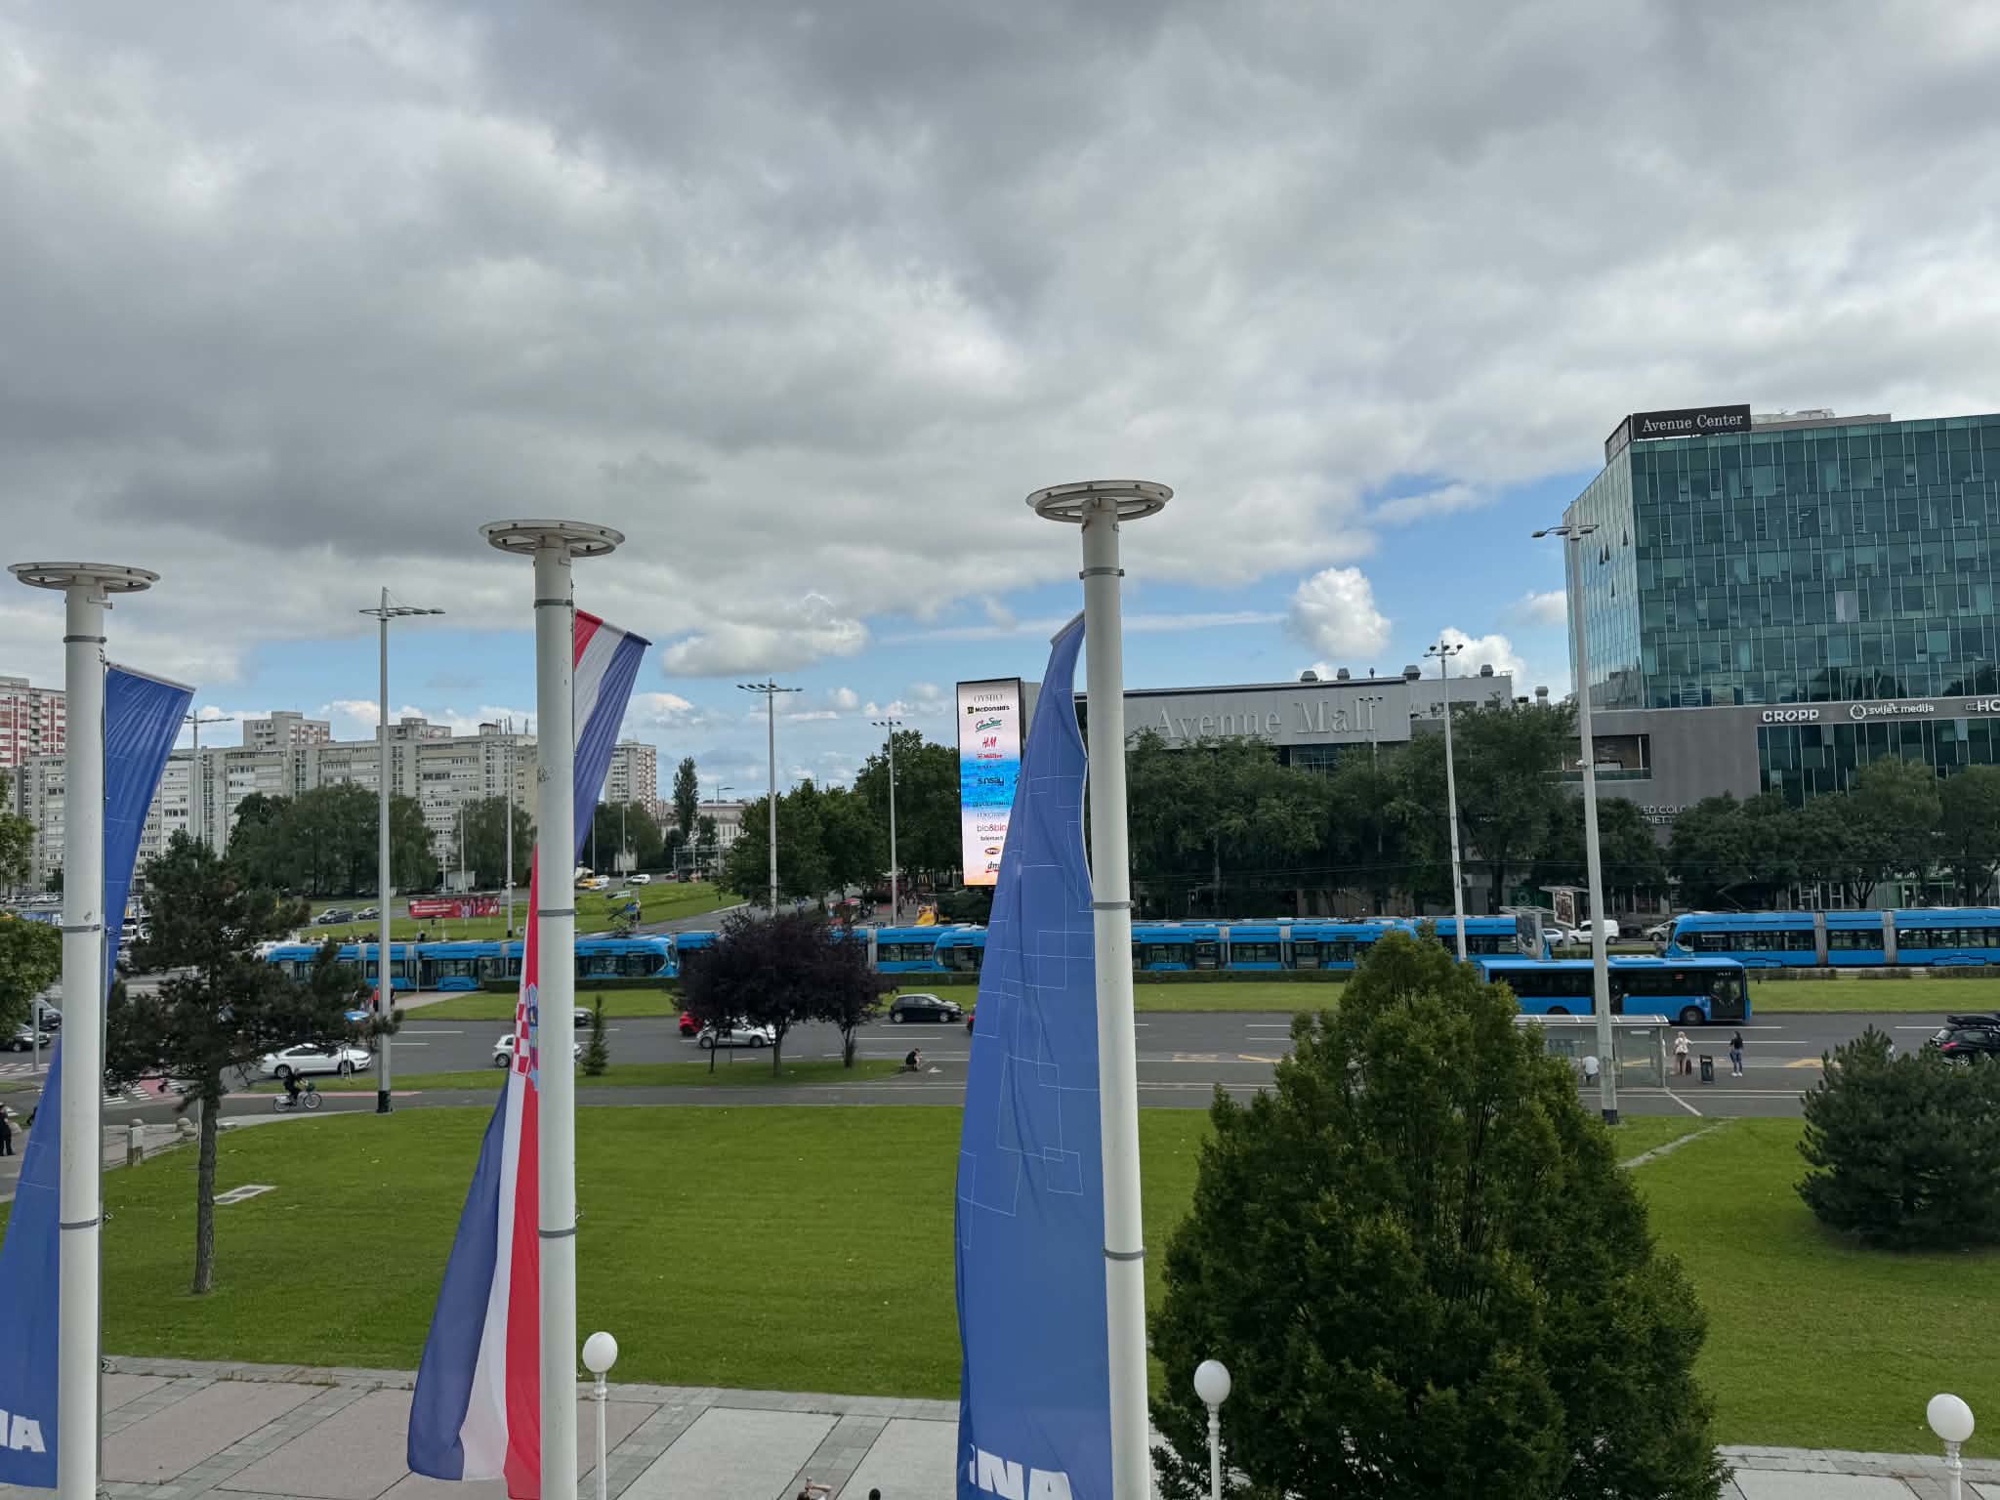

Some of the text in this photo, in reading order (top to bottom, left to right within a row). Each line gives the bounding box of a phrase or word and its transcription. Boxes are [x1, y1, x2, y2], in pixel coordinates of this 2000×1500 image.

[1642, 414, 1743, 432] Avenue Center
[1901, 702, 1935, 713] medija
[1155, 699, 1376, 738] Avenue Mall
[1762, 709, 1819, 722] CROPP
